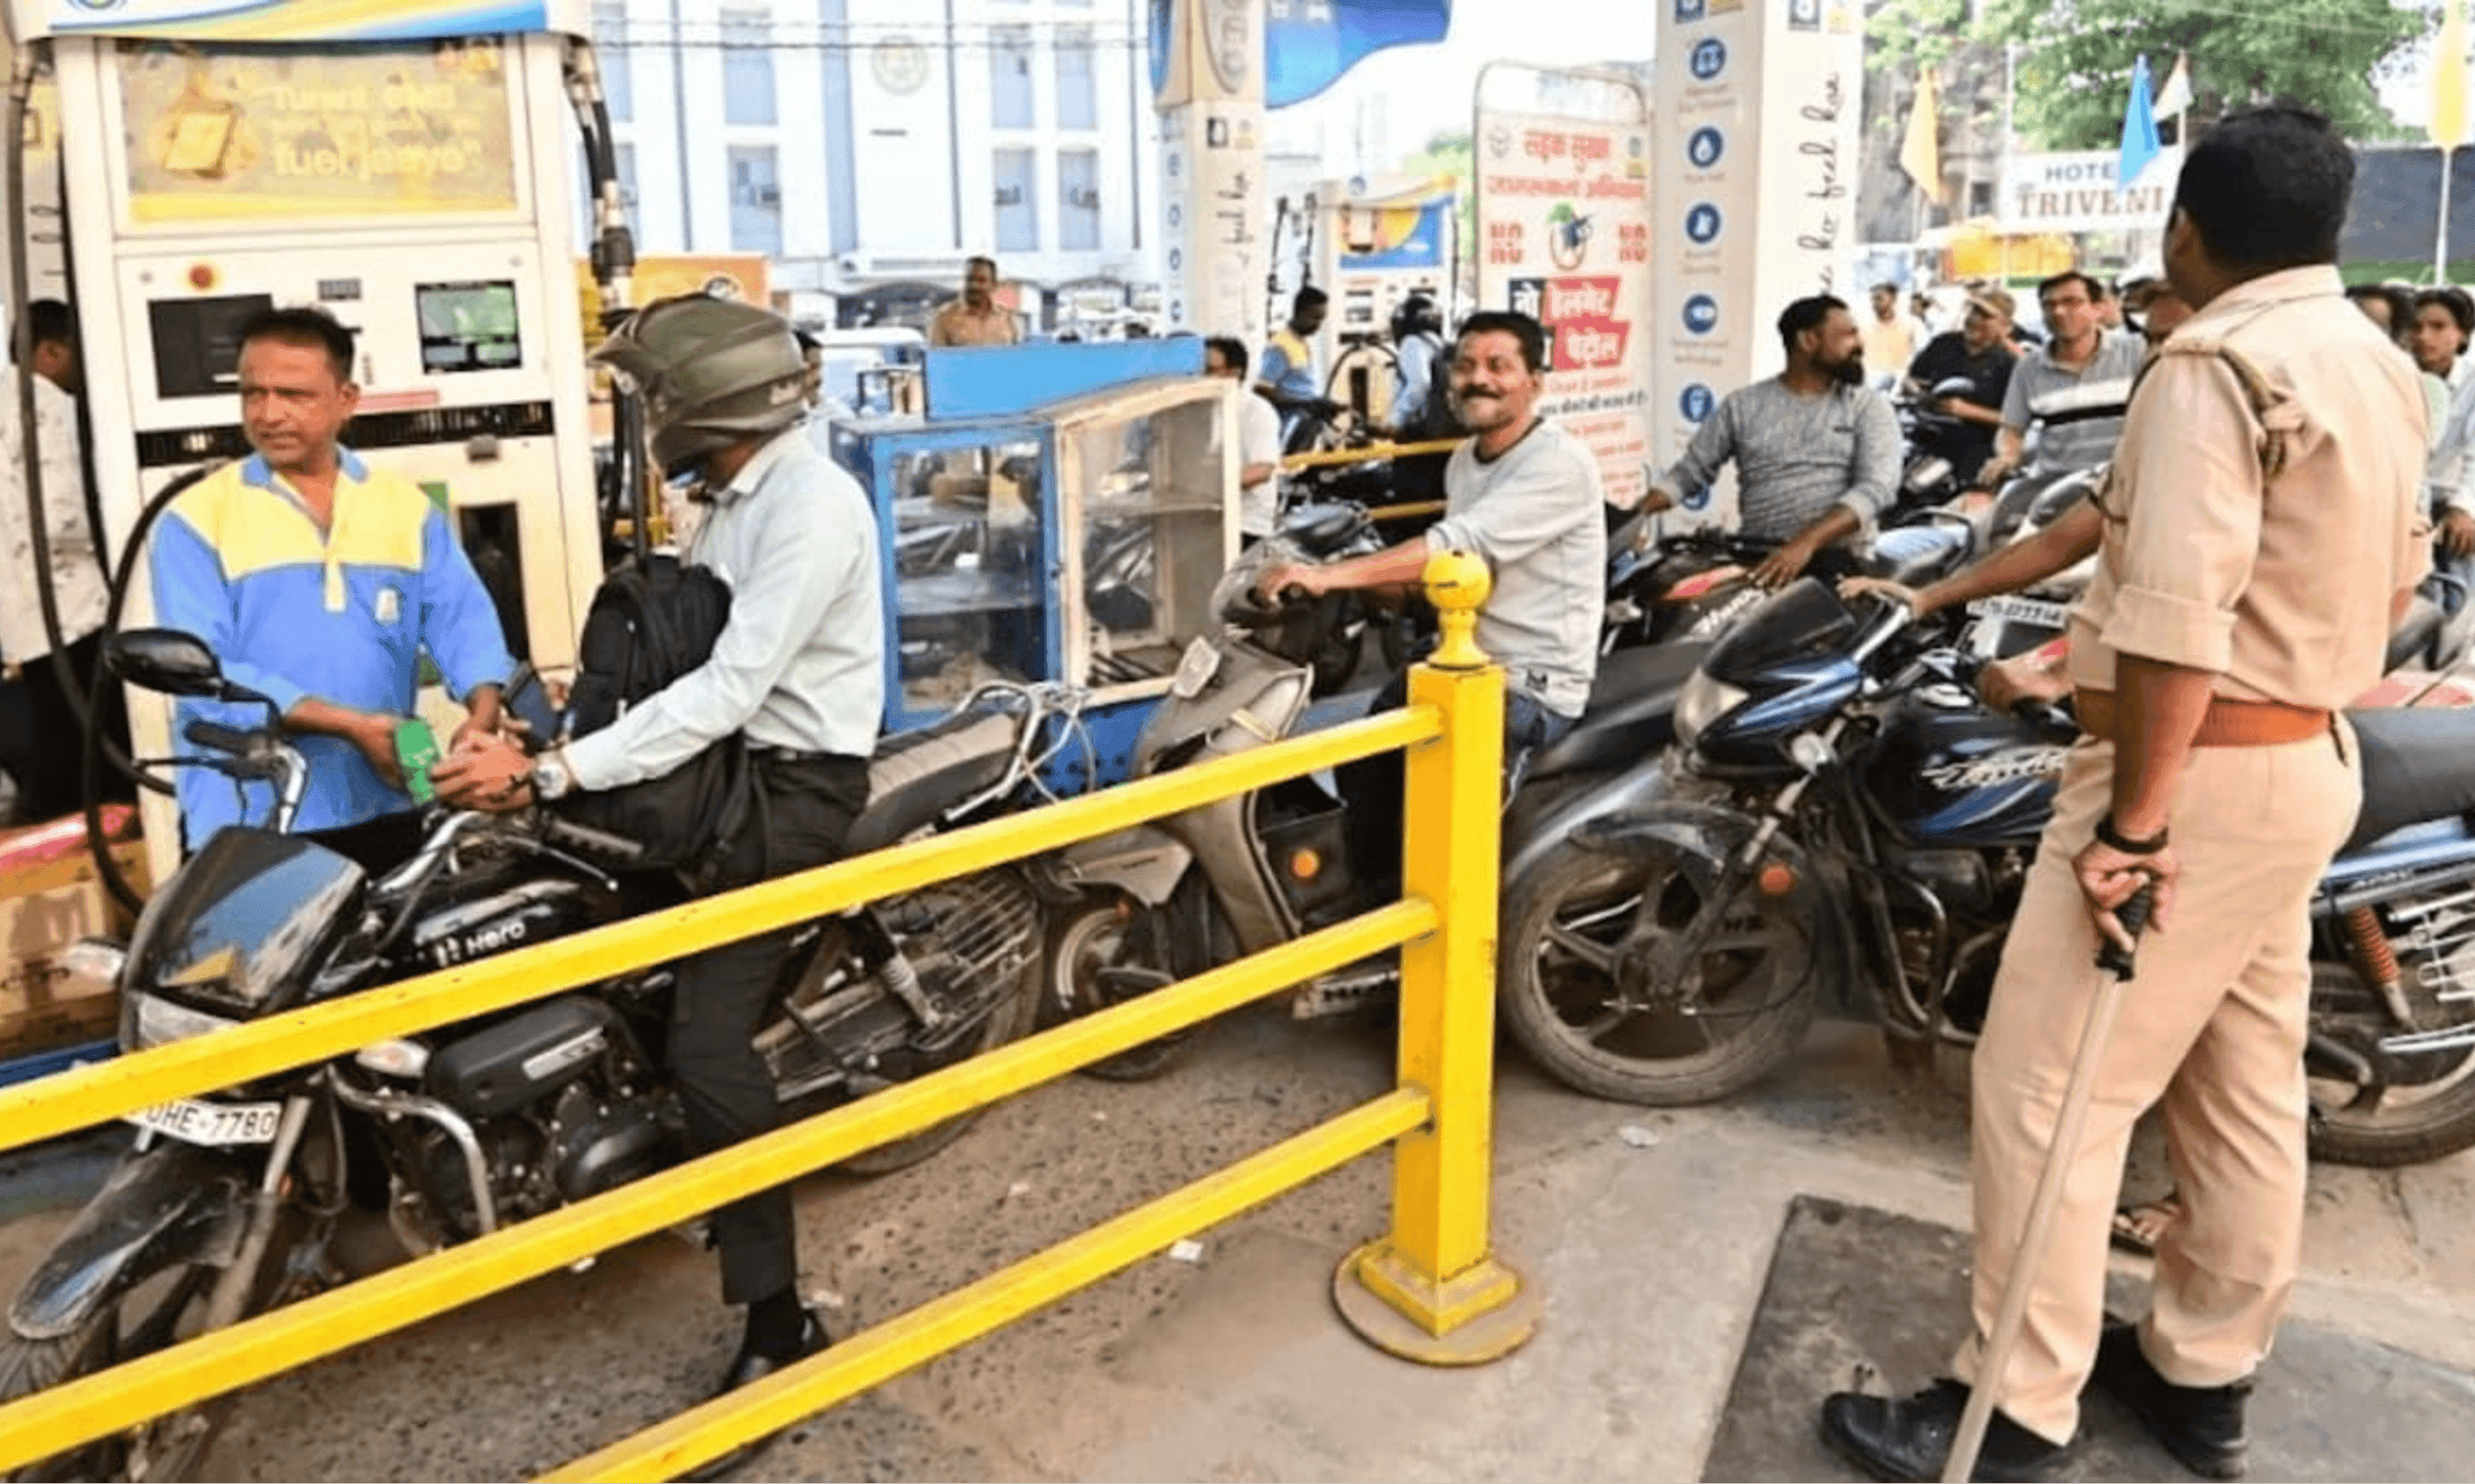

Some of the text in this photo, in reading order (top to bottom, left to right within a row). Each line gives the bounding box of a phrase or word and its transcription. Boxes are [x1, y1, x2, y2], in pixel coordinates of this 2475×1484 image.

[2045, 163, 2115, 182] HOTE
[2017, 186, 2164, 218] TRIVENI
[465, 920, 527, 957] Hero
